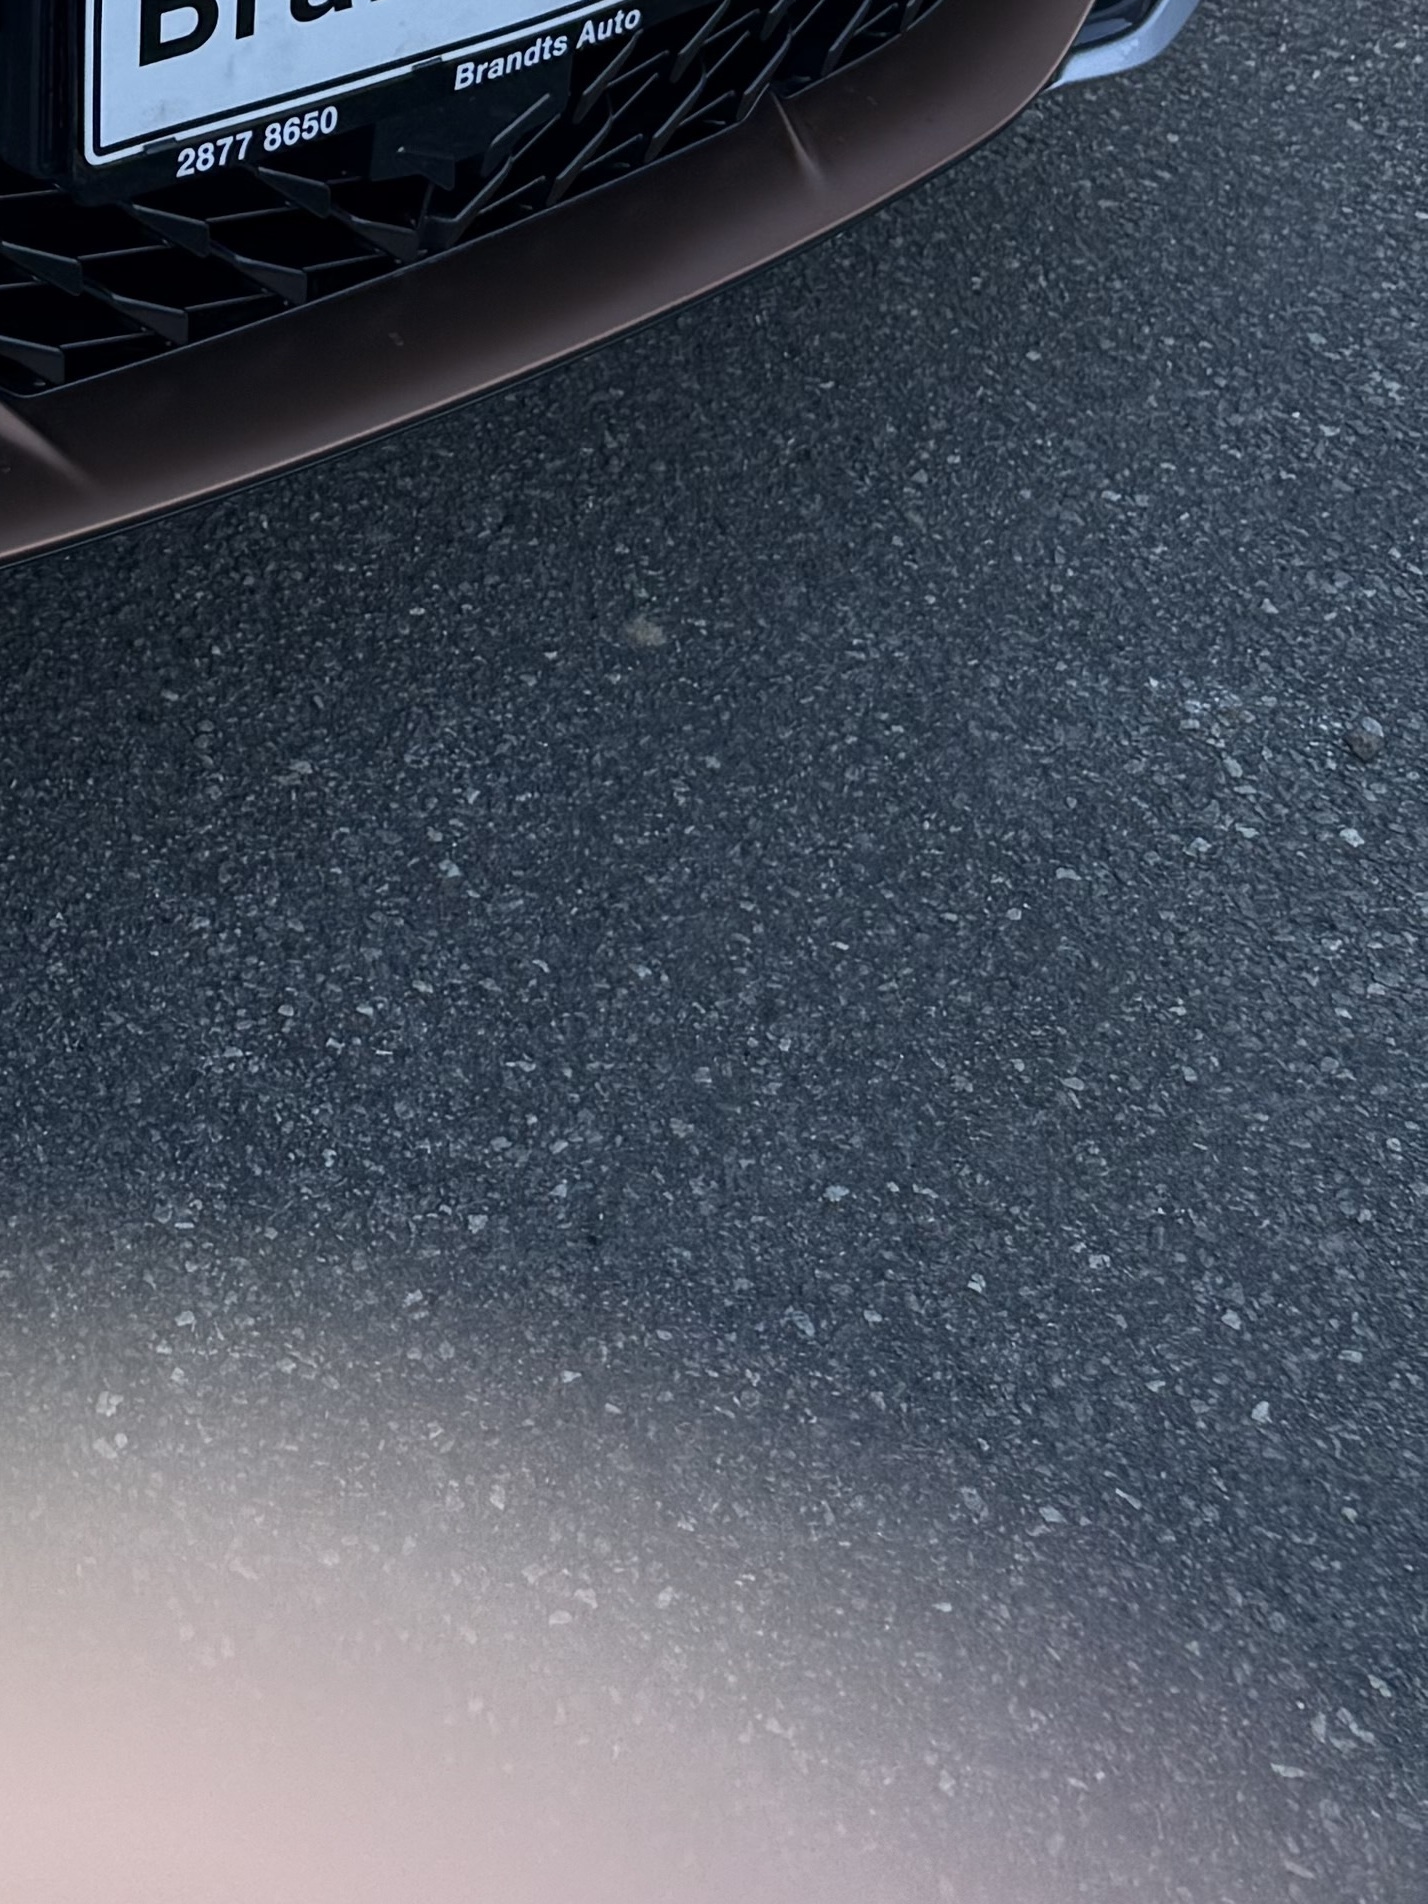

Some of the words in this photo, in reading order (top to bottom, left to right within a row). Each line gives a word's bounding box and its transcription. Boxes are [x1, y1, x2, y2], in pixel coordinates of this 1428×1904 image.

[454, 36, 568, 90] Brandts
[576, 8, 642, 50] Auto
[176, 130, 253, 178] 2877
[263, 105, 338, 153] 8650
